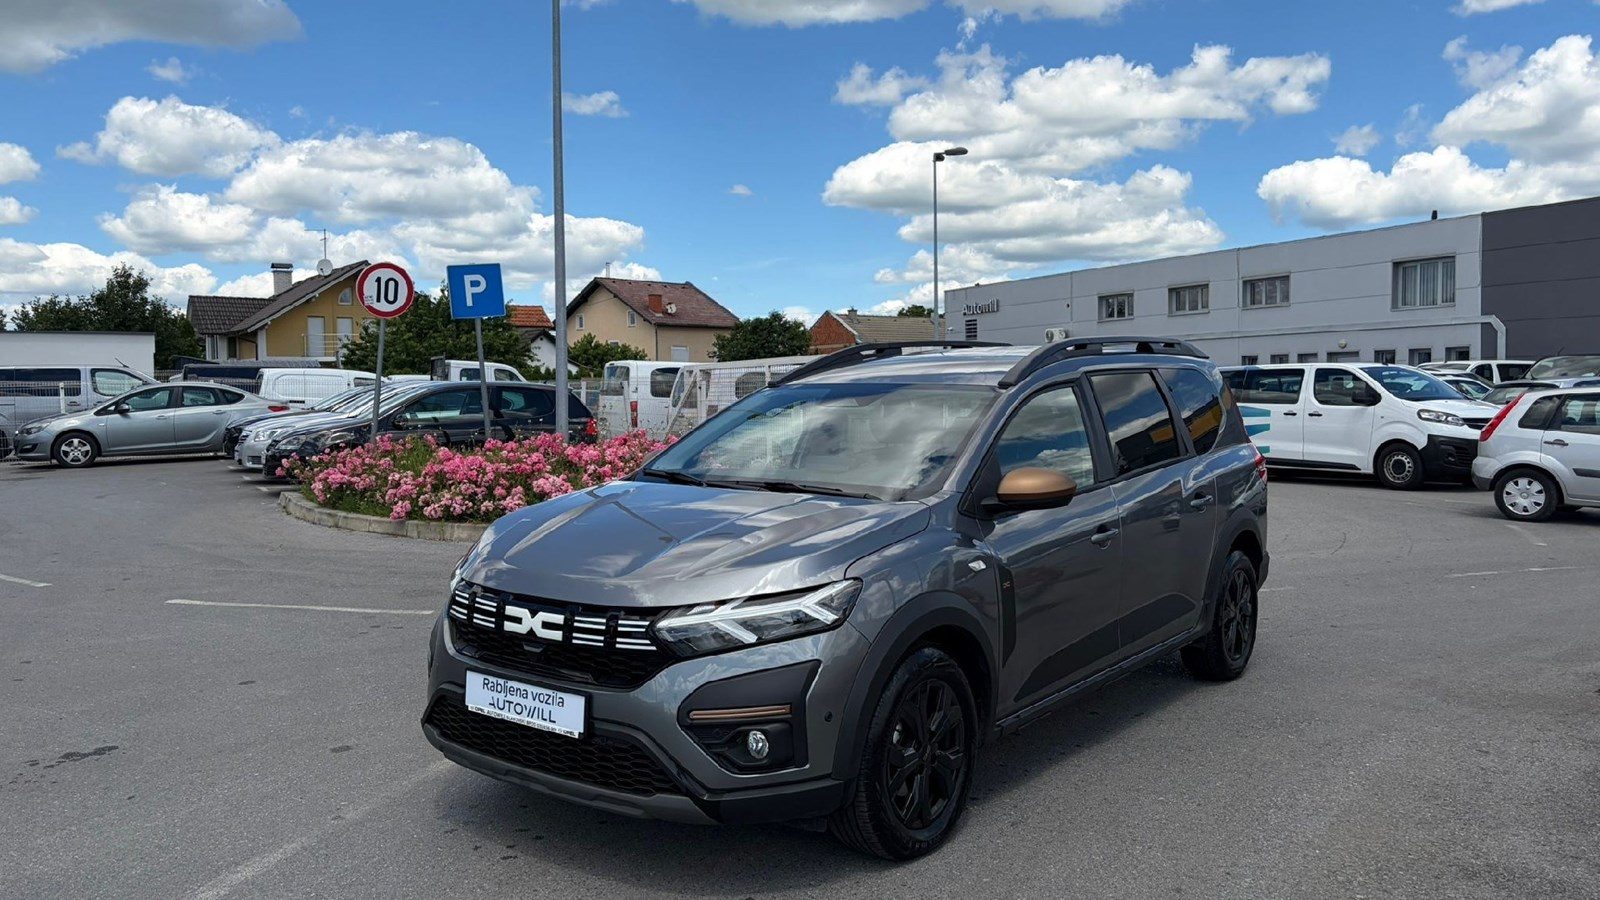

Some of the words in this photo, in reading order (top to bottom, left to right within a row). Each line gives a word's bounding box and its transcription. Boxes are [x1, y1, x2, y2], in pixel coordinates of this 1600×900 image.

[374, 276, 399, 305] 10
[463, 274, 487, 307] P
[482, 677, 529, 699] Rabljena
[531, 690, 565, 708] vozila
[488, 696, 557, 724] AUTOWILL
